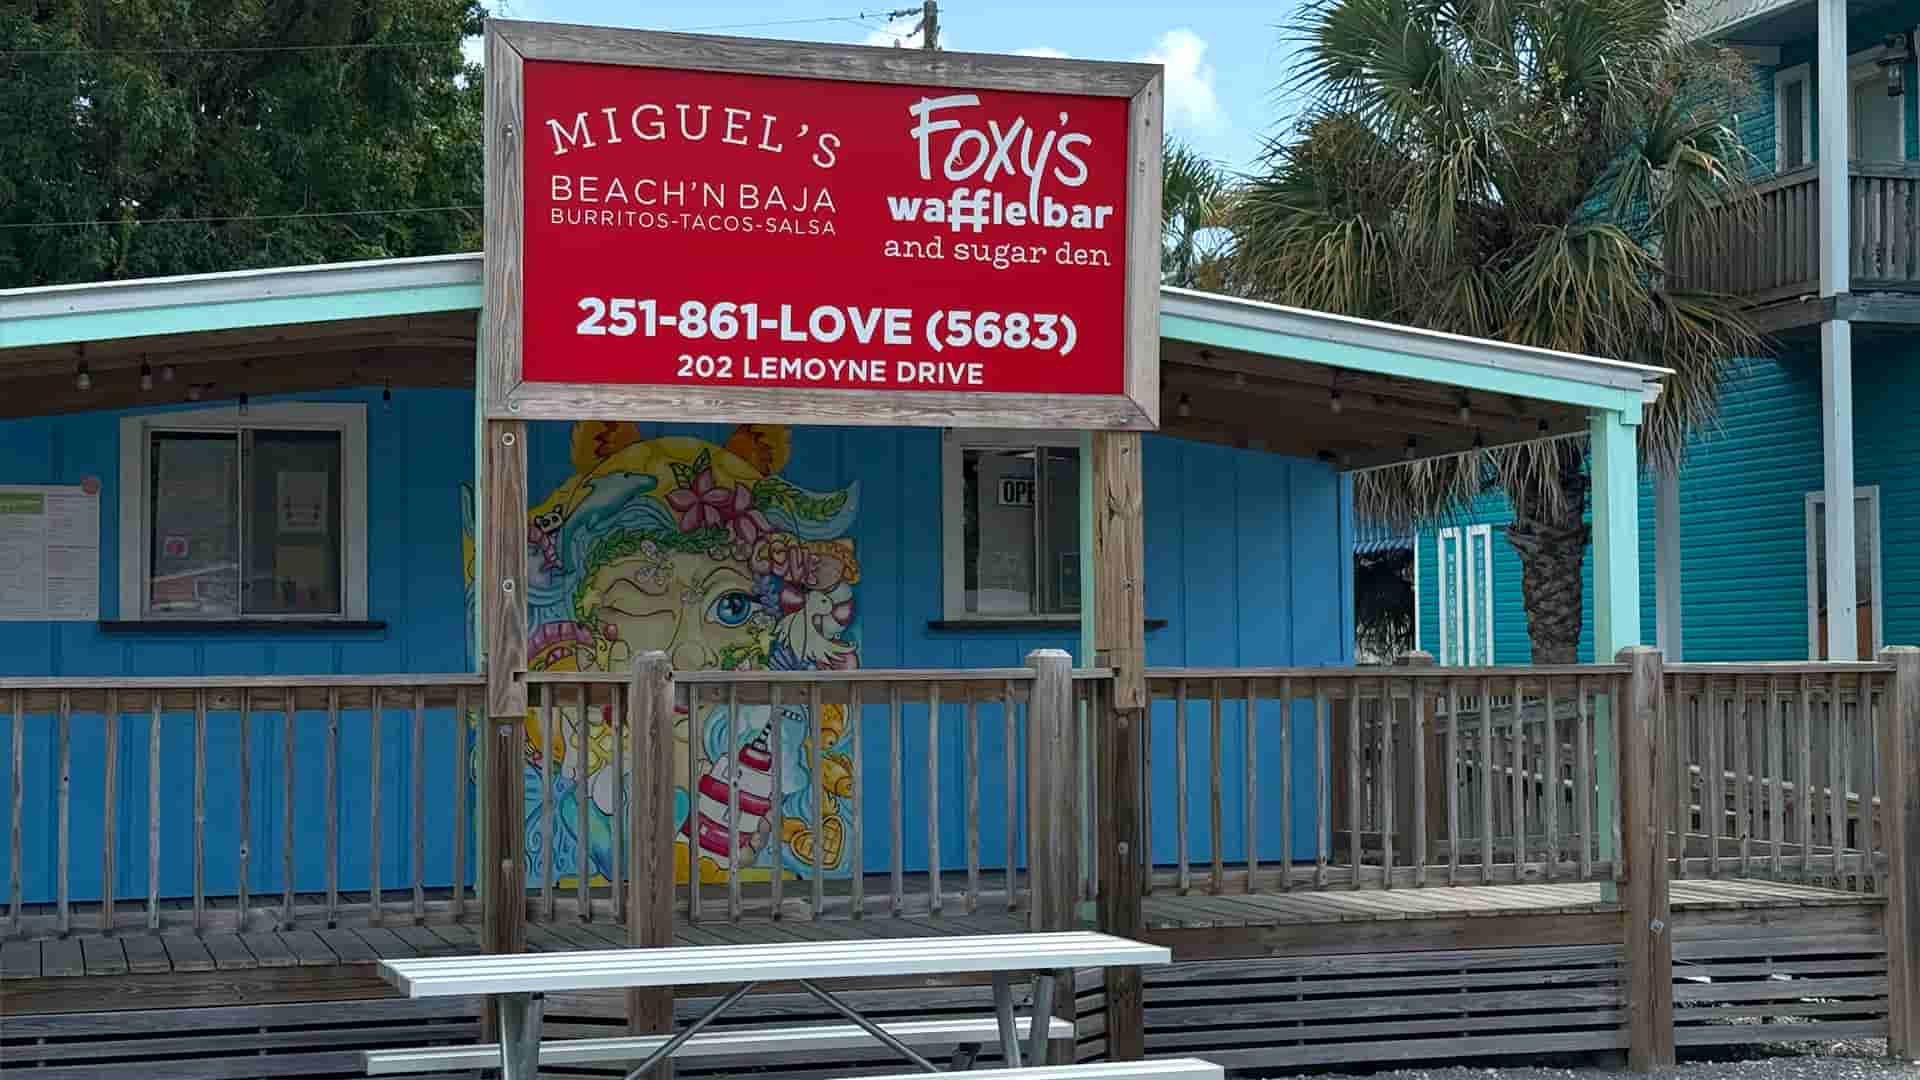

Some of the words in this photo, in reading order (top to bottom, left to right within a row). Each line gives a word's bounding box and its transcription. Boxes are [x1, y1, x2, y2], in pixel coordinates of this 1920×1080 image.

[545, 103, 842, 170] MIGUEL'S
[908, 94, 1092, 225] Foxy's
[551, 175, 725, 209] BEACH'N
[739, 183, 836, 213] BAJA
[886, 188, 1028, 233] waffle
[1043, 195, 1114, 230] bar
[551, 207, 836, 235] BURRITOS-TACOS-SALSA
[884, 239, 945, 259] and
[953, 243, 1047, 270] sugar
[1055, 241, 1111, 267] den
[576, 296, 913, 347] 251-861-LOVE
[925, 309, 1078, 357] (5683)
[677, 354, 733, 378] 202
[743, 356, 887, 383] LEMOYNE
[896, 360, 984, 386] DRIVE
[1003, 480, 1036, 503] OPE
